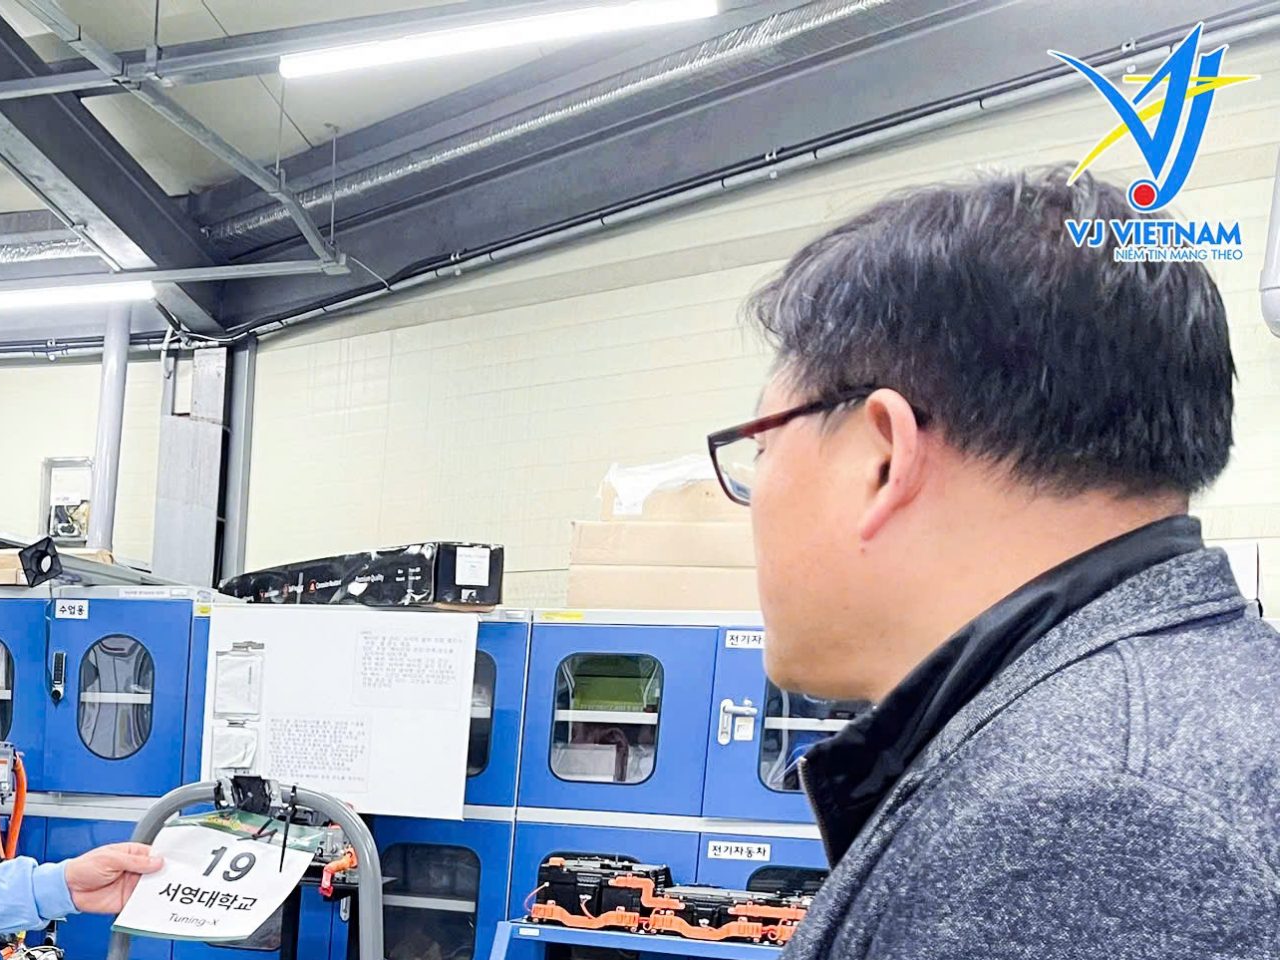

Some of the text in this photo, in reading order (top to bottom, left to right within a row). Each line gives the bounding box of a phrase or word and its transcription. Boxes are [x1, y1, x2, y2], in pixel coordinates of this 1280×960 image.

[58, 604, 86, 616] 수업용
[728, 634, 762, 646] 전기자
[711, 844, 768, 858] 전기자동차
[202, 845, 257, 882] 19
[158, 882, 258, 911] 서영대학교
[168, 912, 220, 927] Tuning-X
